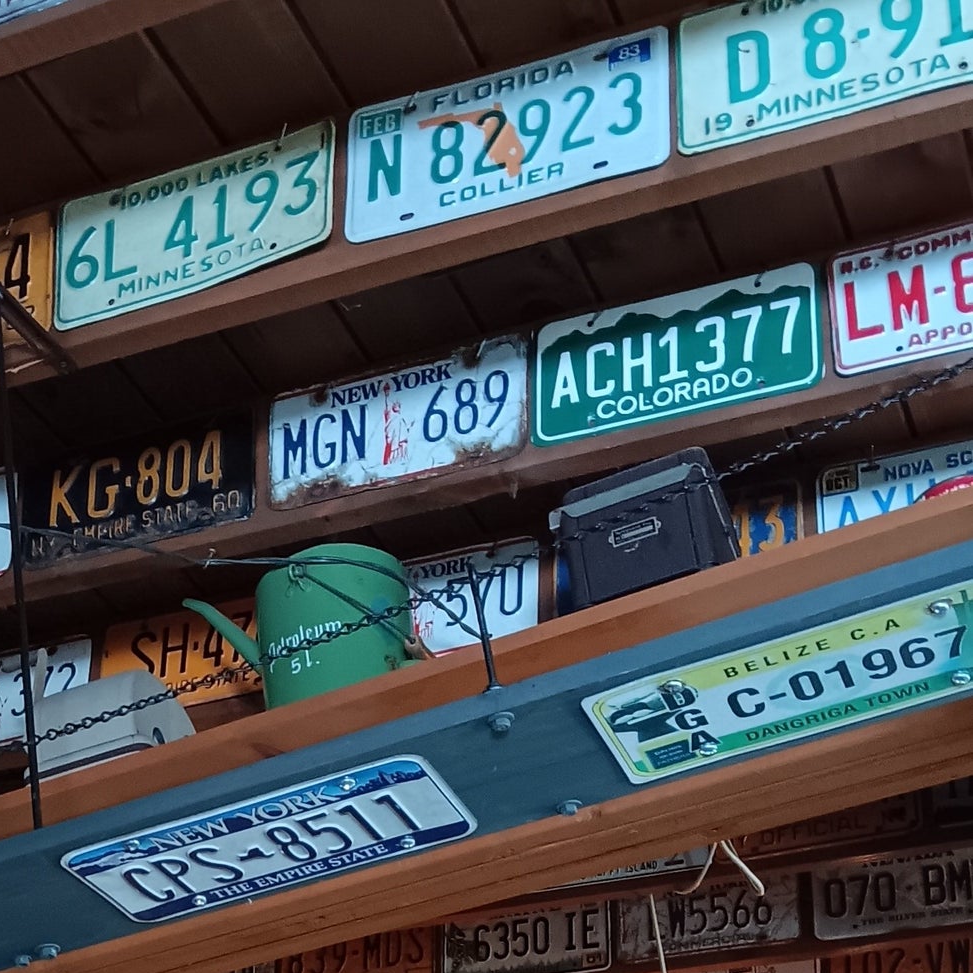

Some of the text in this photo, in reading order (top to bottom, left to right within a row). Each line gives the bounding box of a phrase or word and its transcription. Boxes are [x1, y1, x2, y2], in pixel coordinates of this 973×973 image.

[618, 43, 641, 60] 83
[432, 60, 575, 111] FLORIDA
[756, 54, 950, 122] MINNESOTA
[362, 112, 396, 134] FEB
[430, 72, 643, 184] 82923
[704, 112, 732, 135] 19
[196, 151, 270, 187] LAKES
[439, 161, 564, 207] COLLIER
[65, 149, 319, 289] 6L 4193
[117, 237, 265, 298] MINNESOTA
[549, 295, 803, 410] ACH1377
[330, 361, 453, 409] NEW YORK
[595, 366, 754, 420] COLORADO
[282, 369, 510, 480] MGN 689
[883, 458, 934, 482] NOVA
[418, 555, 475, 581] YORK
[723, 637, 832, 680] BELIZE
[726, 624, 969, 719] C-01967
[744, 701, 859, 744] DANGRIGA
[865, 682, 930, 709] TOWN
[151, 786, 338, 854] NEW YORK
[762, 813, 868, 846] OFFICIAL
[210, 842, 390, 901] THE EMPIRE STATE
